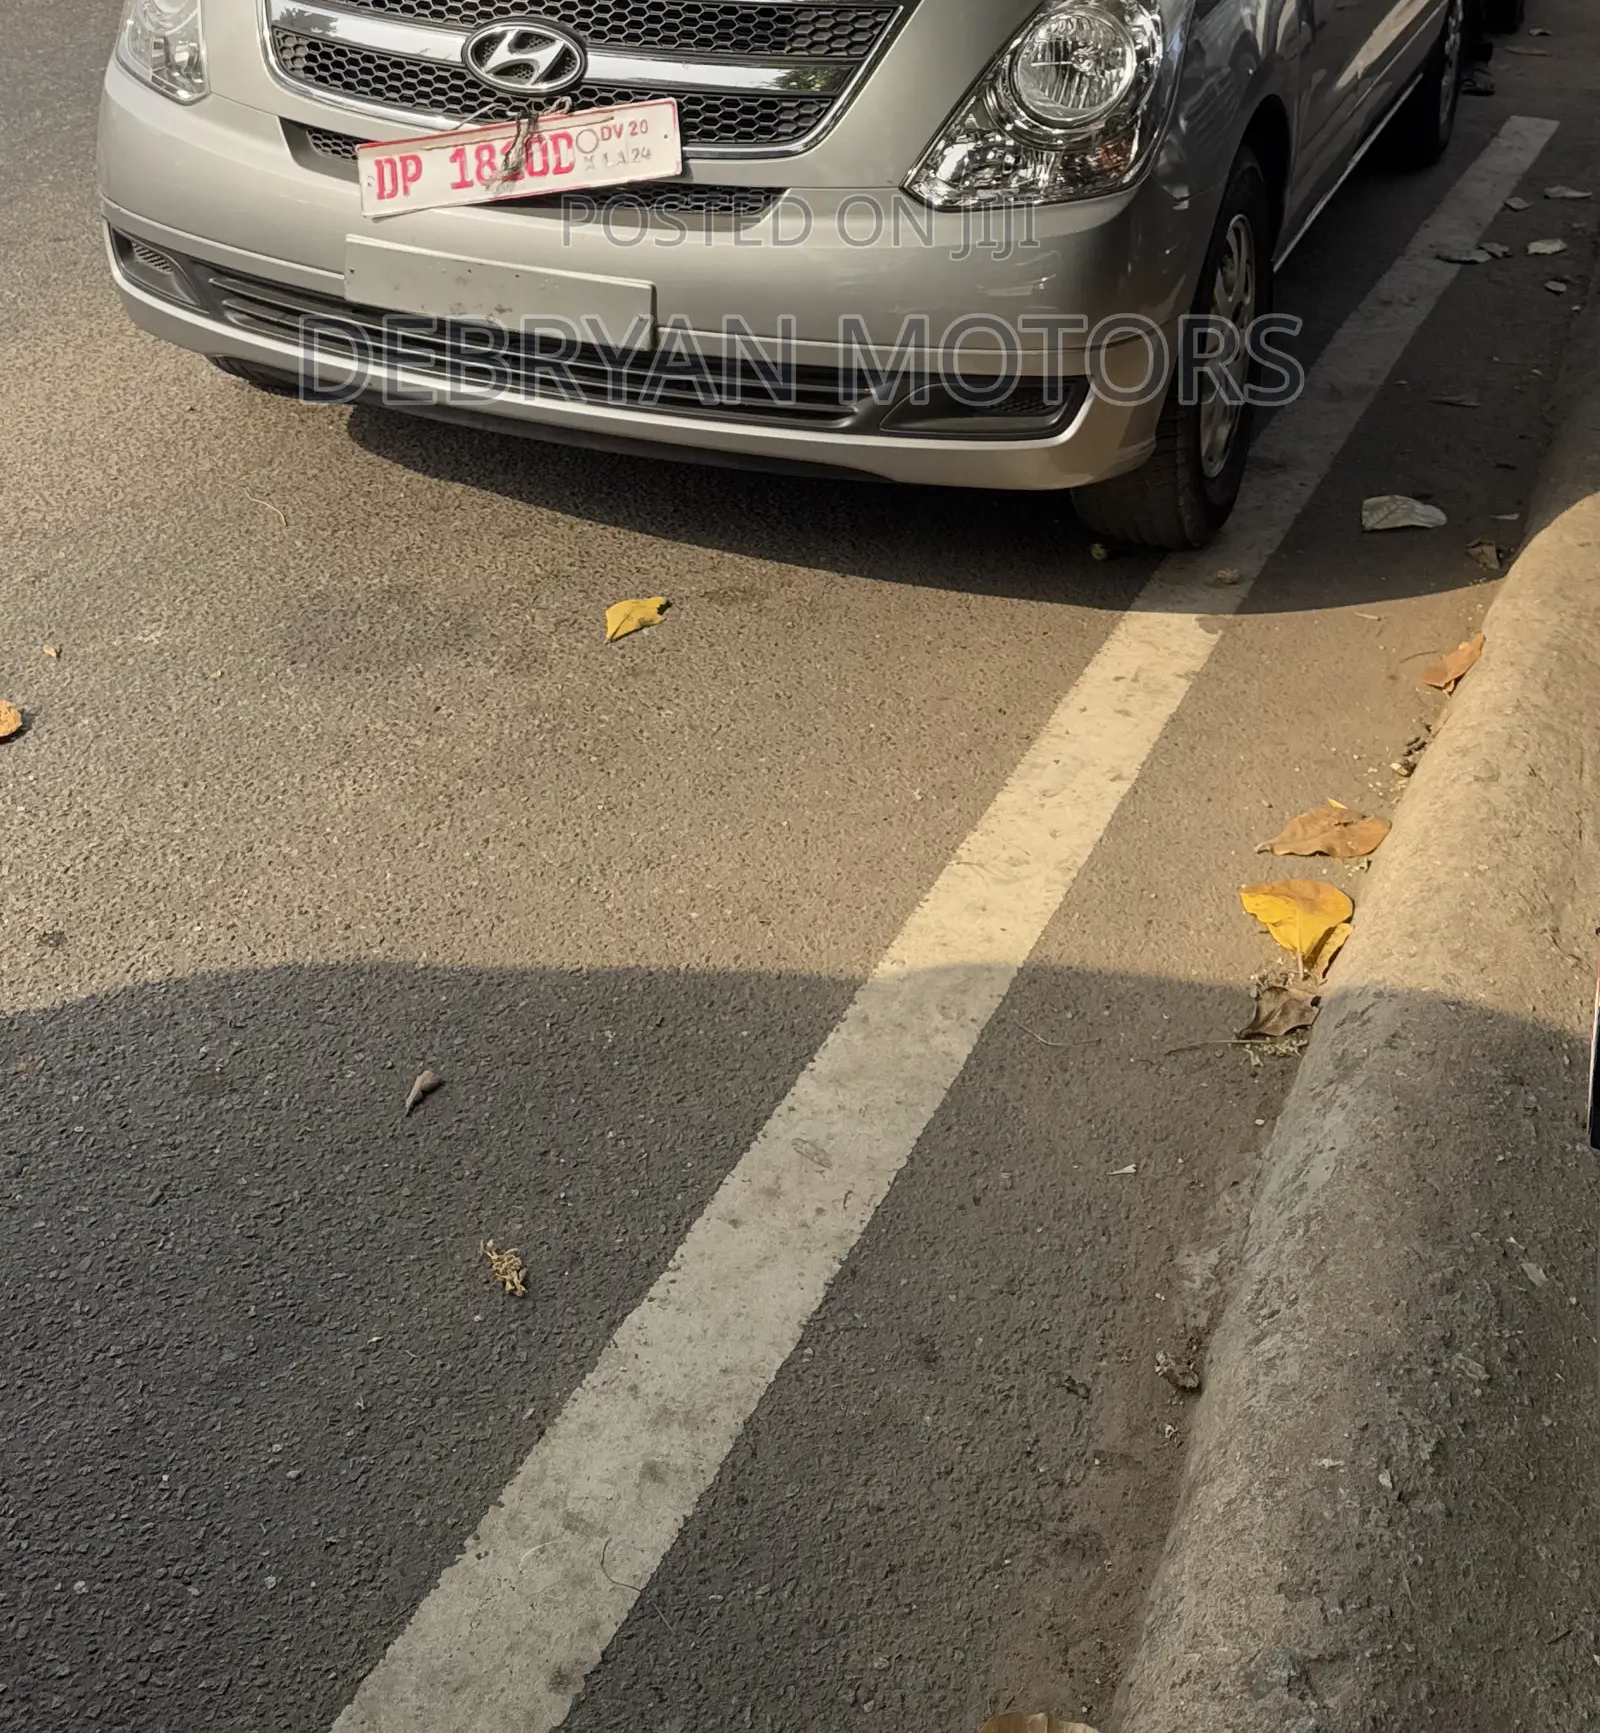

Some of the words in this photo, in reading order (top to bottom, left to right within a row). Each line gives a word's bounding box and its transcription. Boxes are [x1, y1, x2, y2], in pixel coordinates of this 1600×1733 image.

[600, 123, 624, 141] DV
[628, 118, 649, 136] 20
[373, 154, 423, 200] DP
